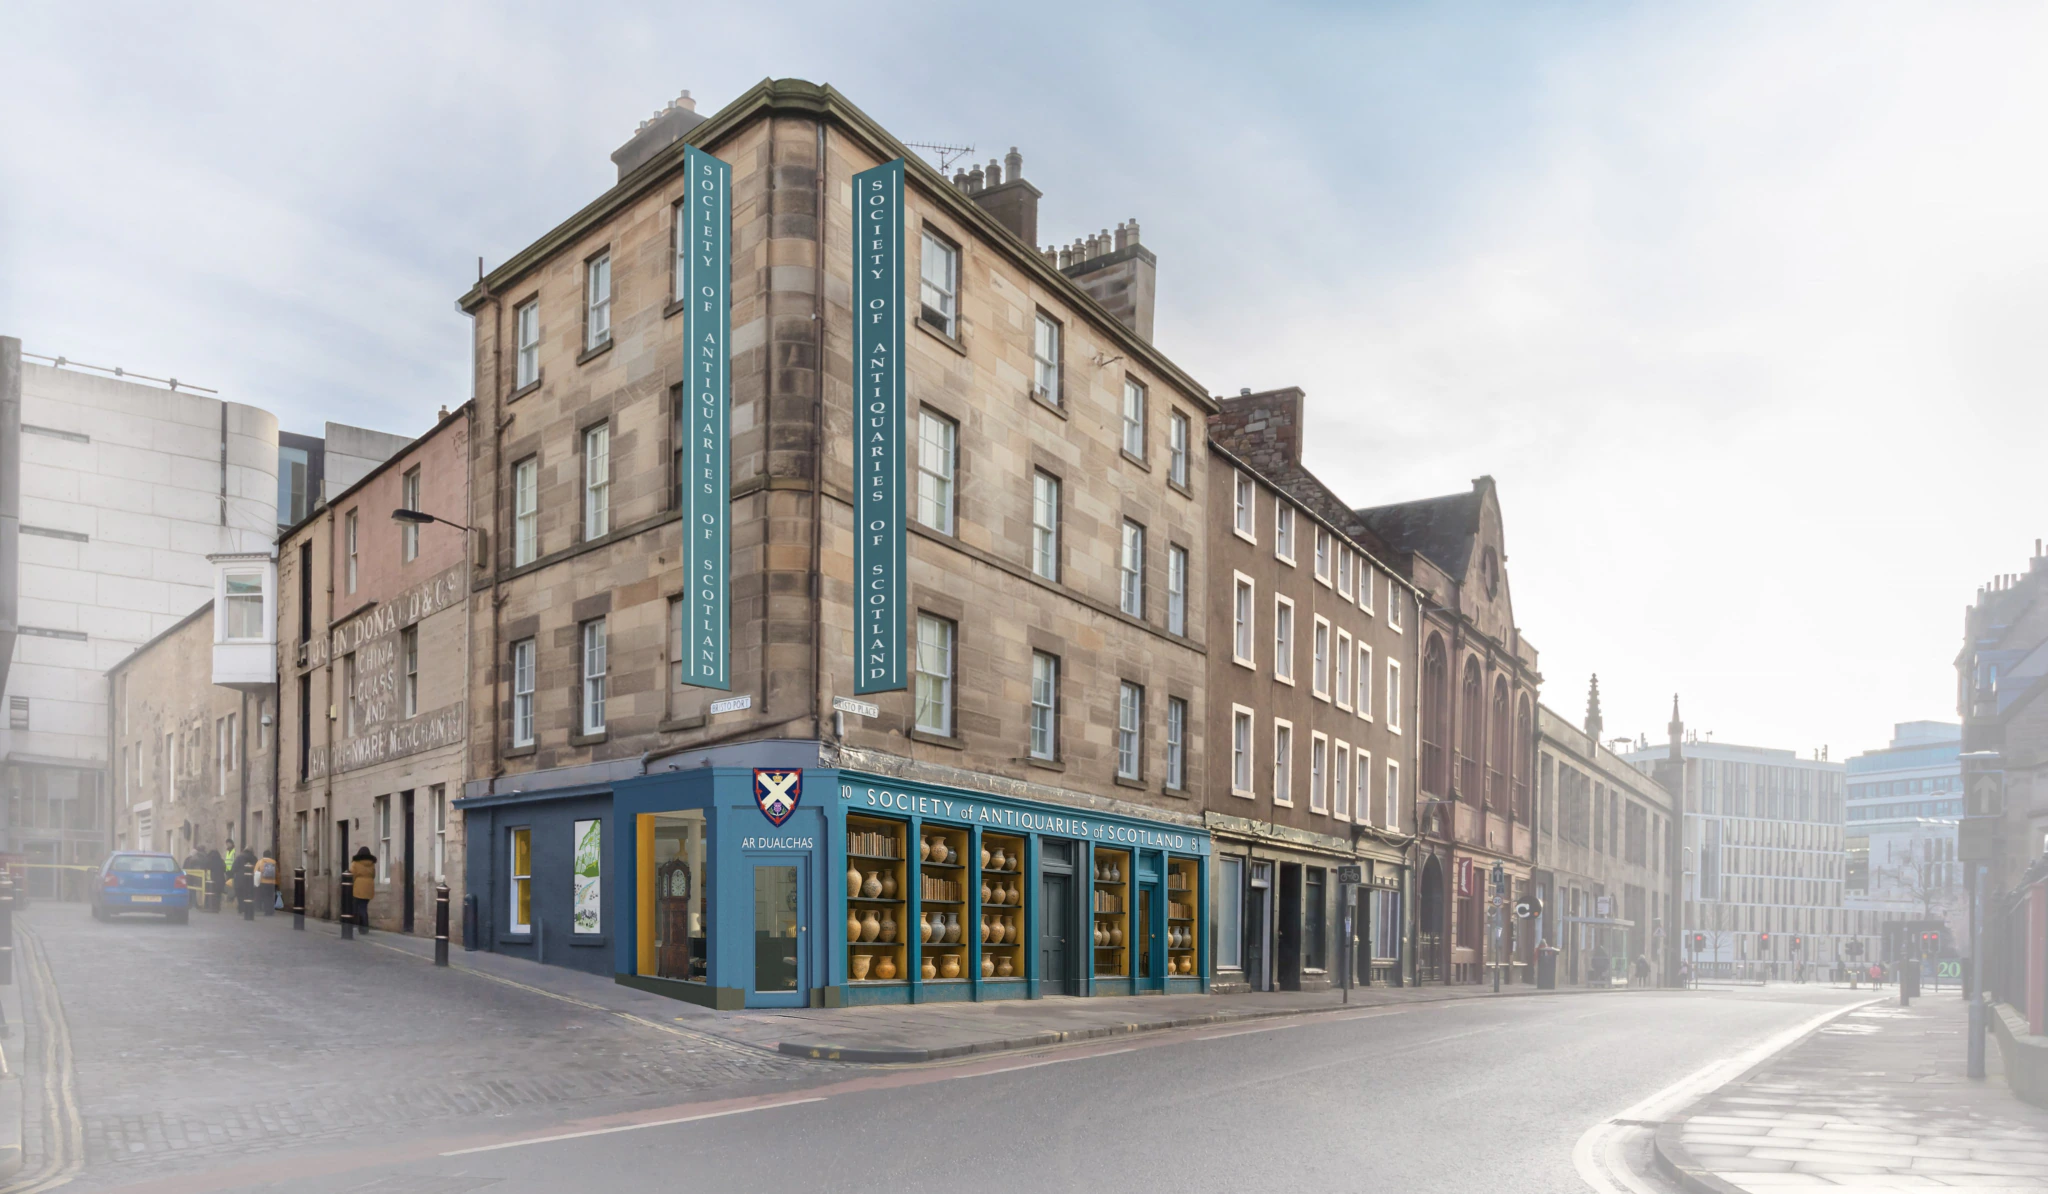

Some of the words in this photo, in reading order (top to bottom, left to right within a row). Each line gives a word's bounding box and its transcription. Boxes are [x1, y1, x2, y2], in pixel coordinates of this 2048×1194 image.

[701, 165, 714, 267] SOCIETY
[869, 180, 885, 280] SOCIETY
[701, 286, 714, 312] OF
[869, 298, 885, 324] OF
[701, 332, 715, 494] ANTIQUARIES
[869, 342, 887, 502] ANTIQUARIES
[702, 513, 715, 540] OF
[870, 520, 885, 546] OF
[701, 559, 714, 677] SCOTLAND
[870, 564, 885, 679] SCOTLAND
[359, 641, 394, 674] CHINA
[357, 669, 394, 702] GLASS
[364, 702, 387, 727] AND
[711, 700, 732, 713] BRISTO
[733, 698, 750, 709] PORT
[834, 698, 856, 712] BRISTO
[857, 705, 877, 717] PLACE
[841, 785, 852, 799] 10
[867, 788, 955, 817] SOCIETY
[960, 804, 974, 820] of
[980, 806, 1088, 837] ANTIQUARIES
[1093, 824, 1105, 840] of
[1107, 825, 1184, 850] SCOTLAND
[741, 837, 756, 849] AR
[758, 837, 814, 849] DUALCHAS
[1939, 962, 1961, 977] 20
